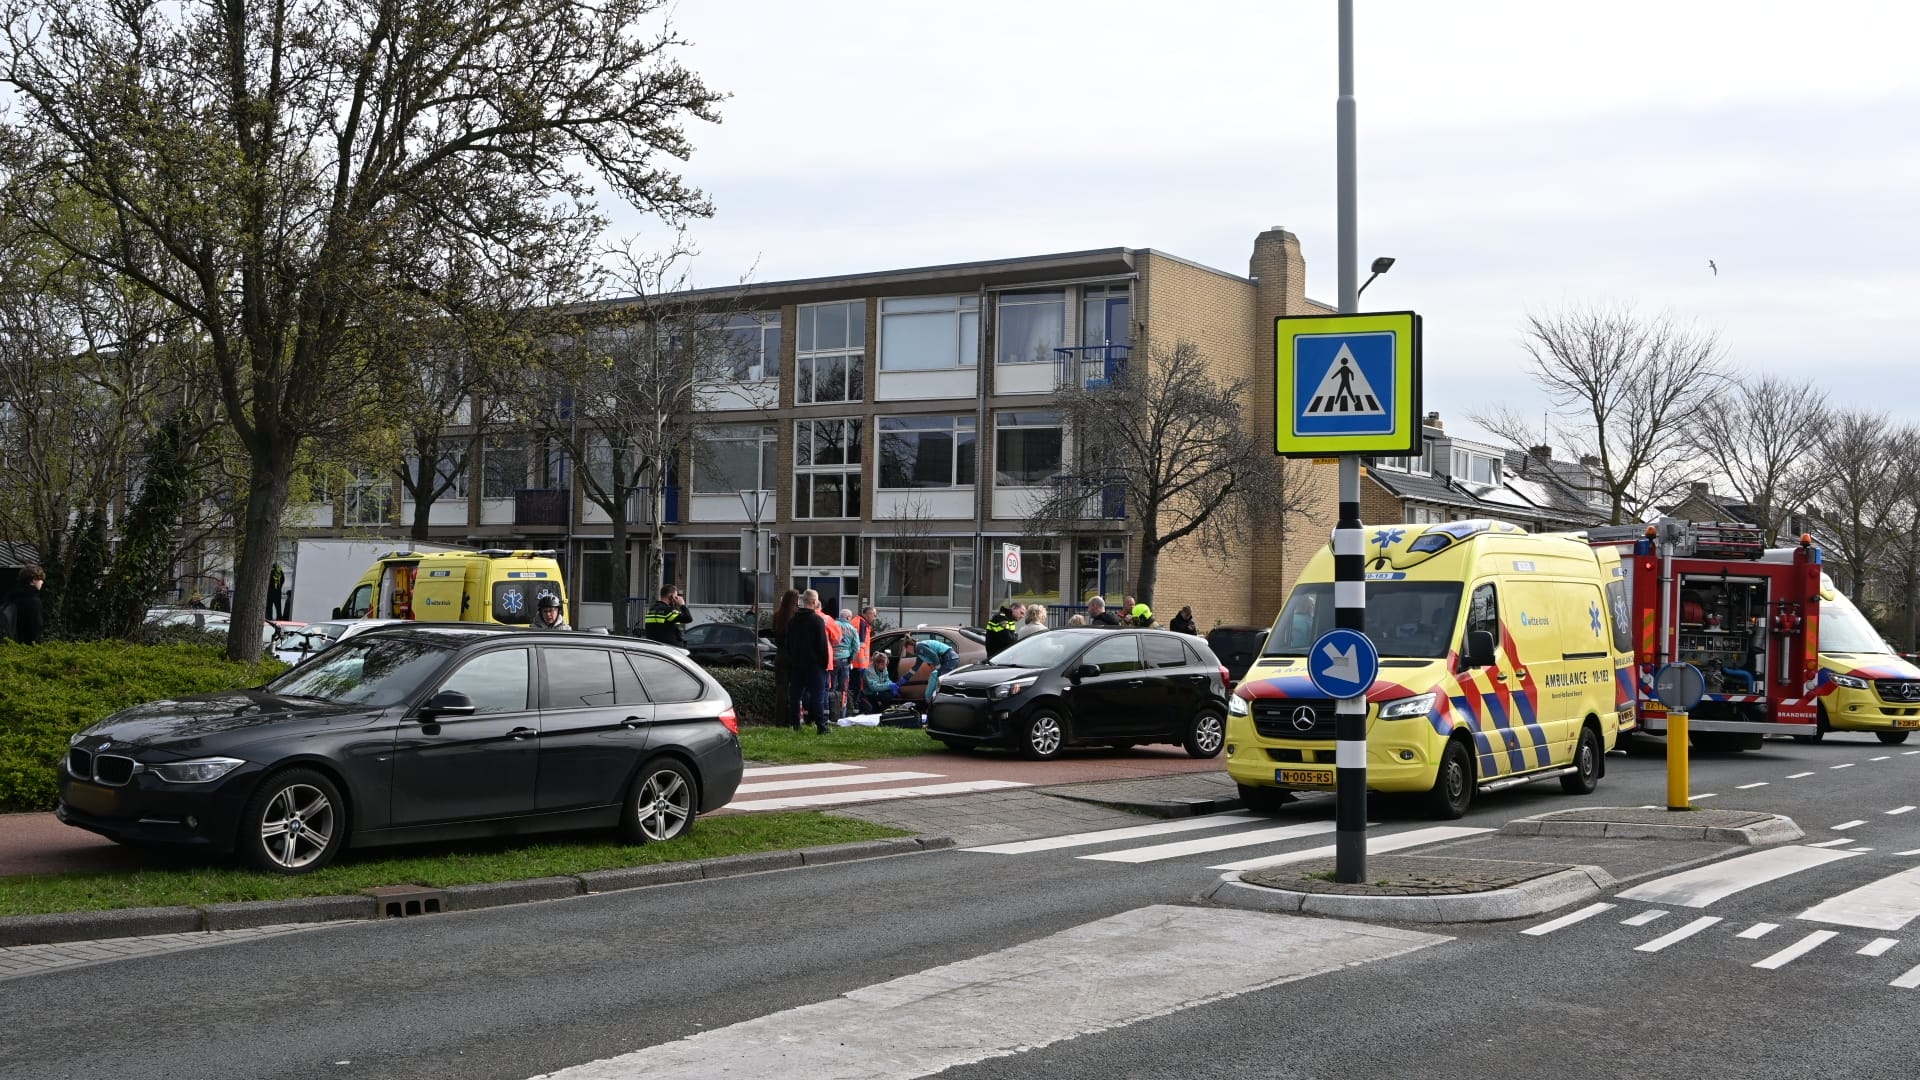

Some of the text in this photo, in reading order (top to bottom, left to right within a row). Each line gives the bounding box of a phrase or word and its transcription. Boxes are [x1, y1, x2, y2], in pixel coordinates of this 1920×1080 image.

[1545, 669, 1609, 689] AMBULANCE 10-183
[1777, 711, 1817, 719] BRANDWEER
[1282, 771, 1331, 783] N-005-RS
